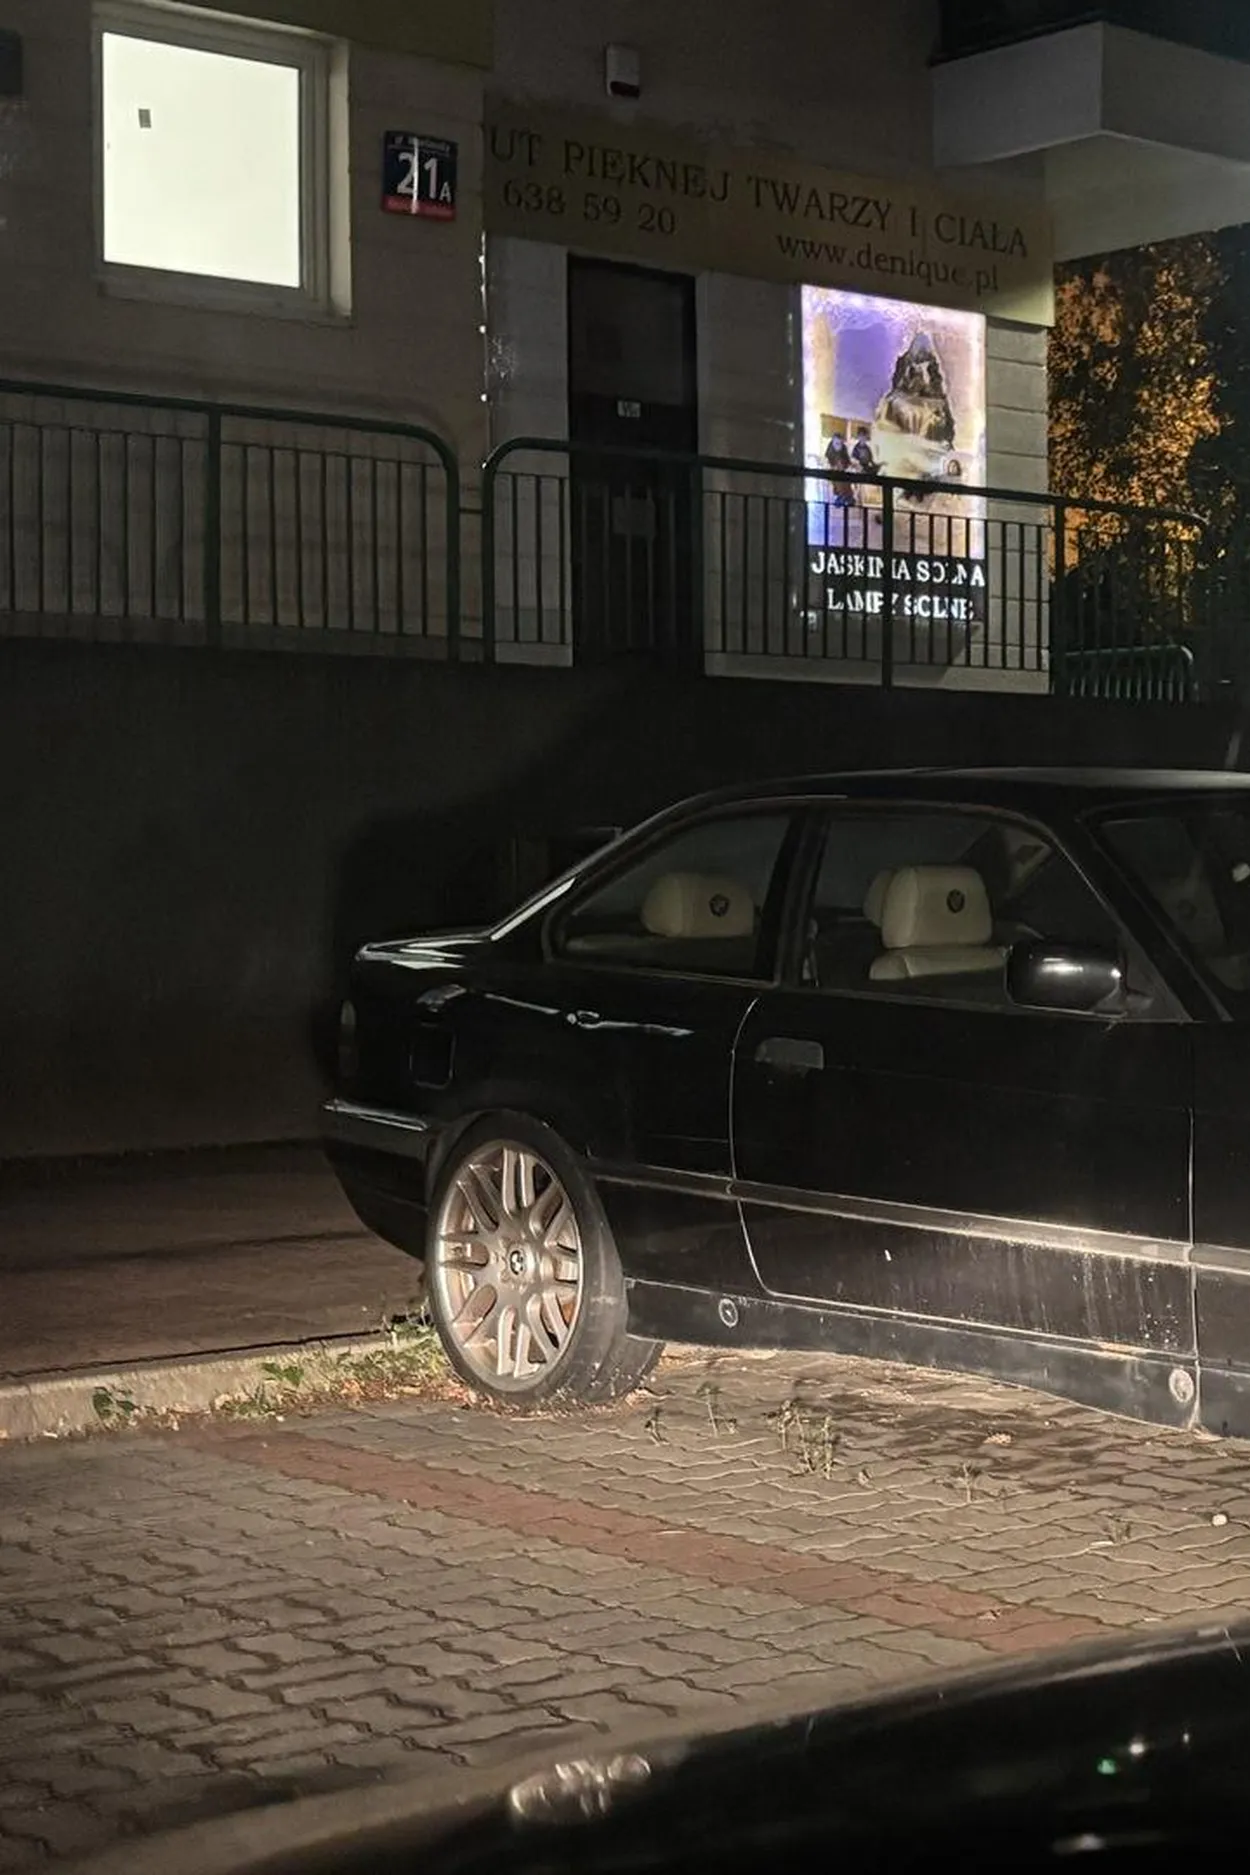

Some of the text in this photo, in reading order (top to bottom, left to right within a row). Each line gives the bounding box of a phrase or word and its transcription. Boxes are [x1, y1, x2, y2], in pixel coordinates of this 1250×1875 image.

[503, 180, 678, 234] 638 59 20
[747, 175, 891, 231] TWARZY
[909, 205, 918, 236] I
[776, 233, 998, 296] www.denique.pl
